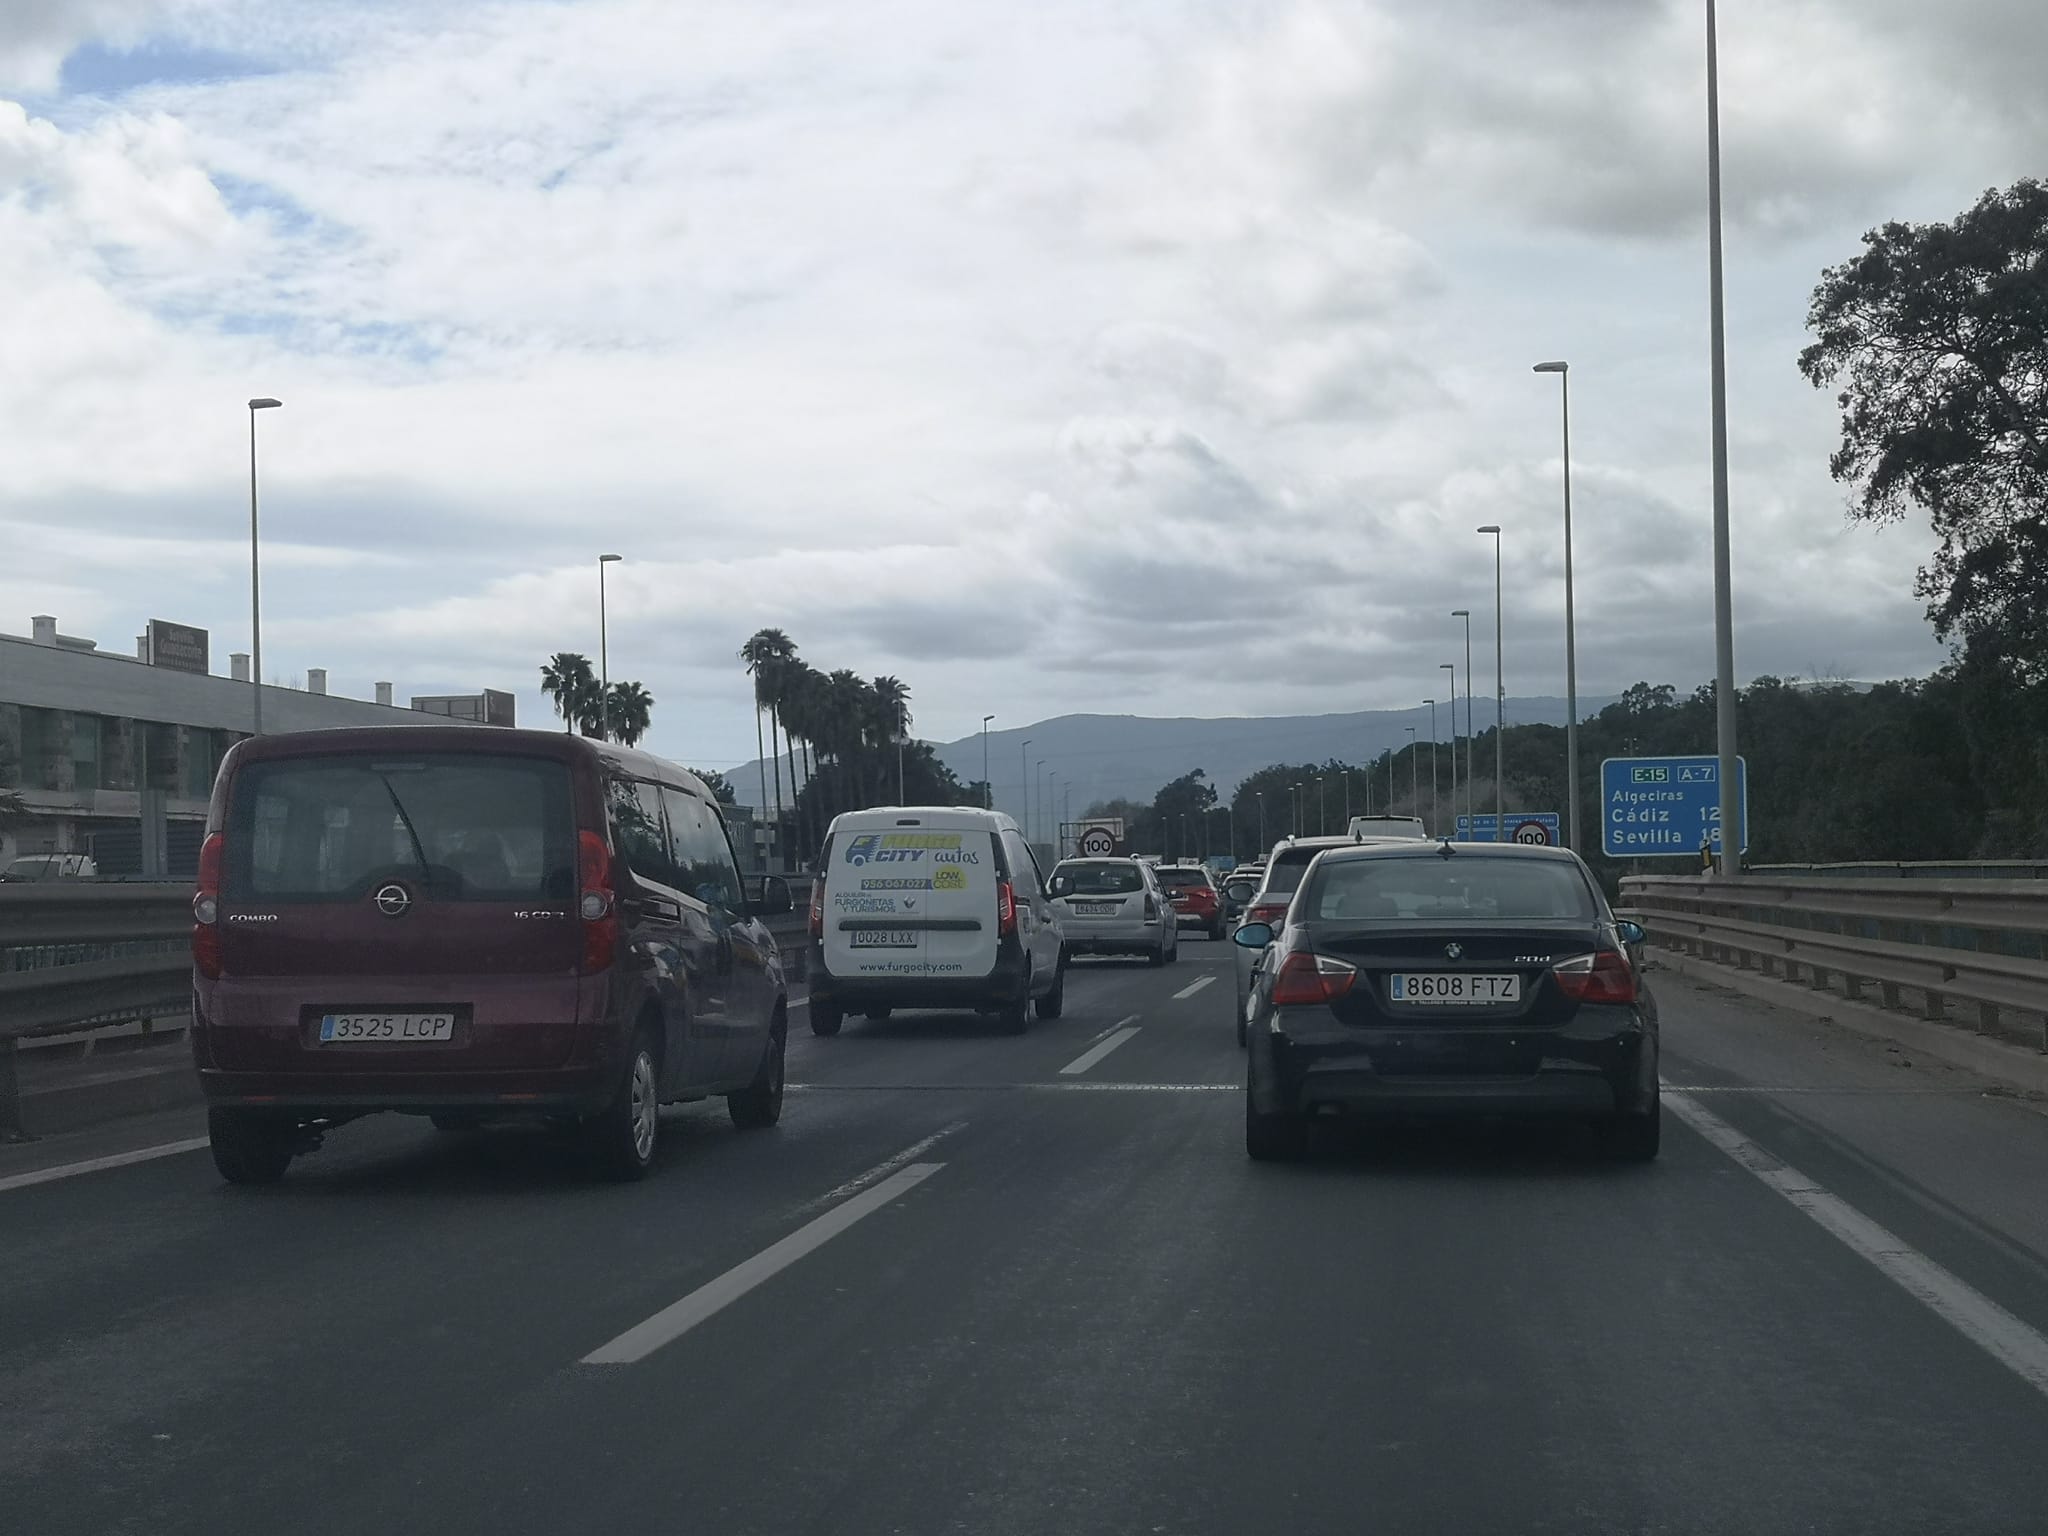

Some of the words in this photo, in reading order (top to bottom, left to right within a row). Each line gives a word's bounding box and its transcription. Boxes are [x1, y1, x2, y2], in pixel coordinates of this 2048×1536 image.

[1634, 769, 1665, 781] E-15
[1681, 768, 1712, 780] A-7
[1612, 790, 1684, 804] Algeciras
[1611, 807, 1670, 822] Cádiz
[1518, 832, 1545, 845] 100
[1612, 829, 1682, 844] Sevilla
[1085, 839, 1111, 853] 100
[875, 850, 925, 862] CITY
[934, 846, 979, 865] autos
[935, 871, 960, 880] LOW
[834, 898, 894, 906] FURGONETAS
[850, 905, 896, 913] TURISMOS
[857, 932, 887, 944] 0028
[891, 932, 914, 944] LXX
[859, 961, 963, 973] www.furgocity.com
[1408, 977, 1463, 996] 8608
[1472, 977, 1513, 997] FTZ
[337, 1018, 394, 1037] 3525
[403, 1018, 447, 1037] LCP
